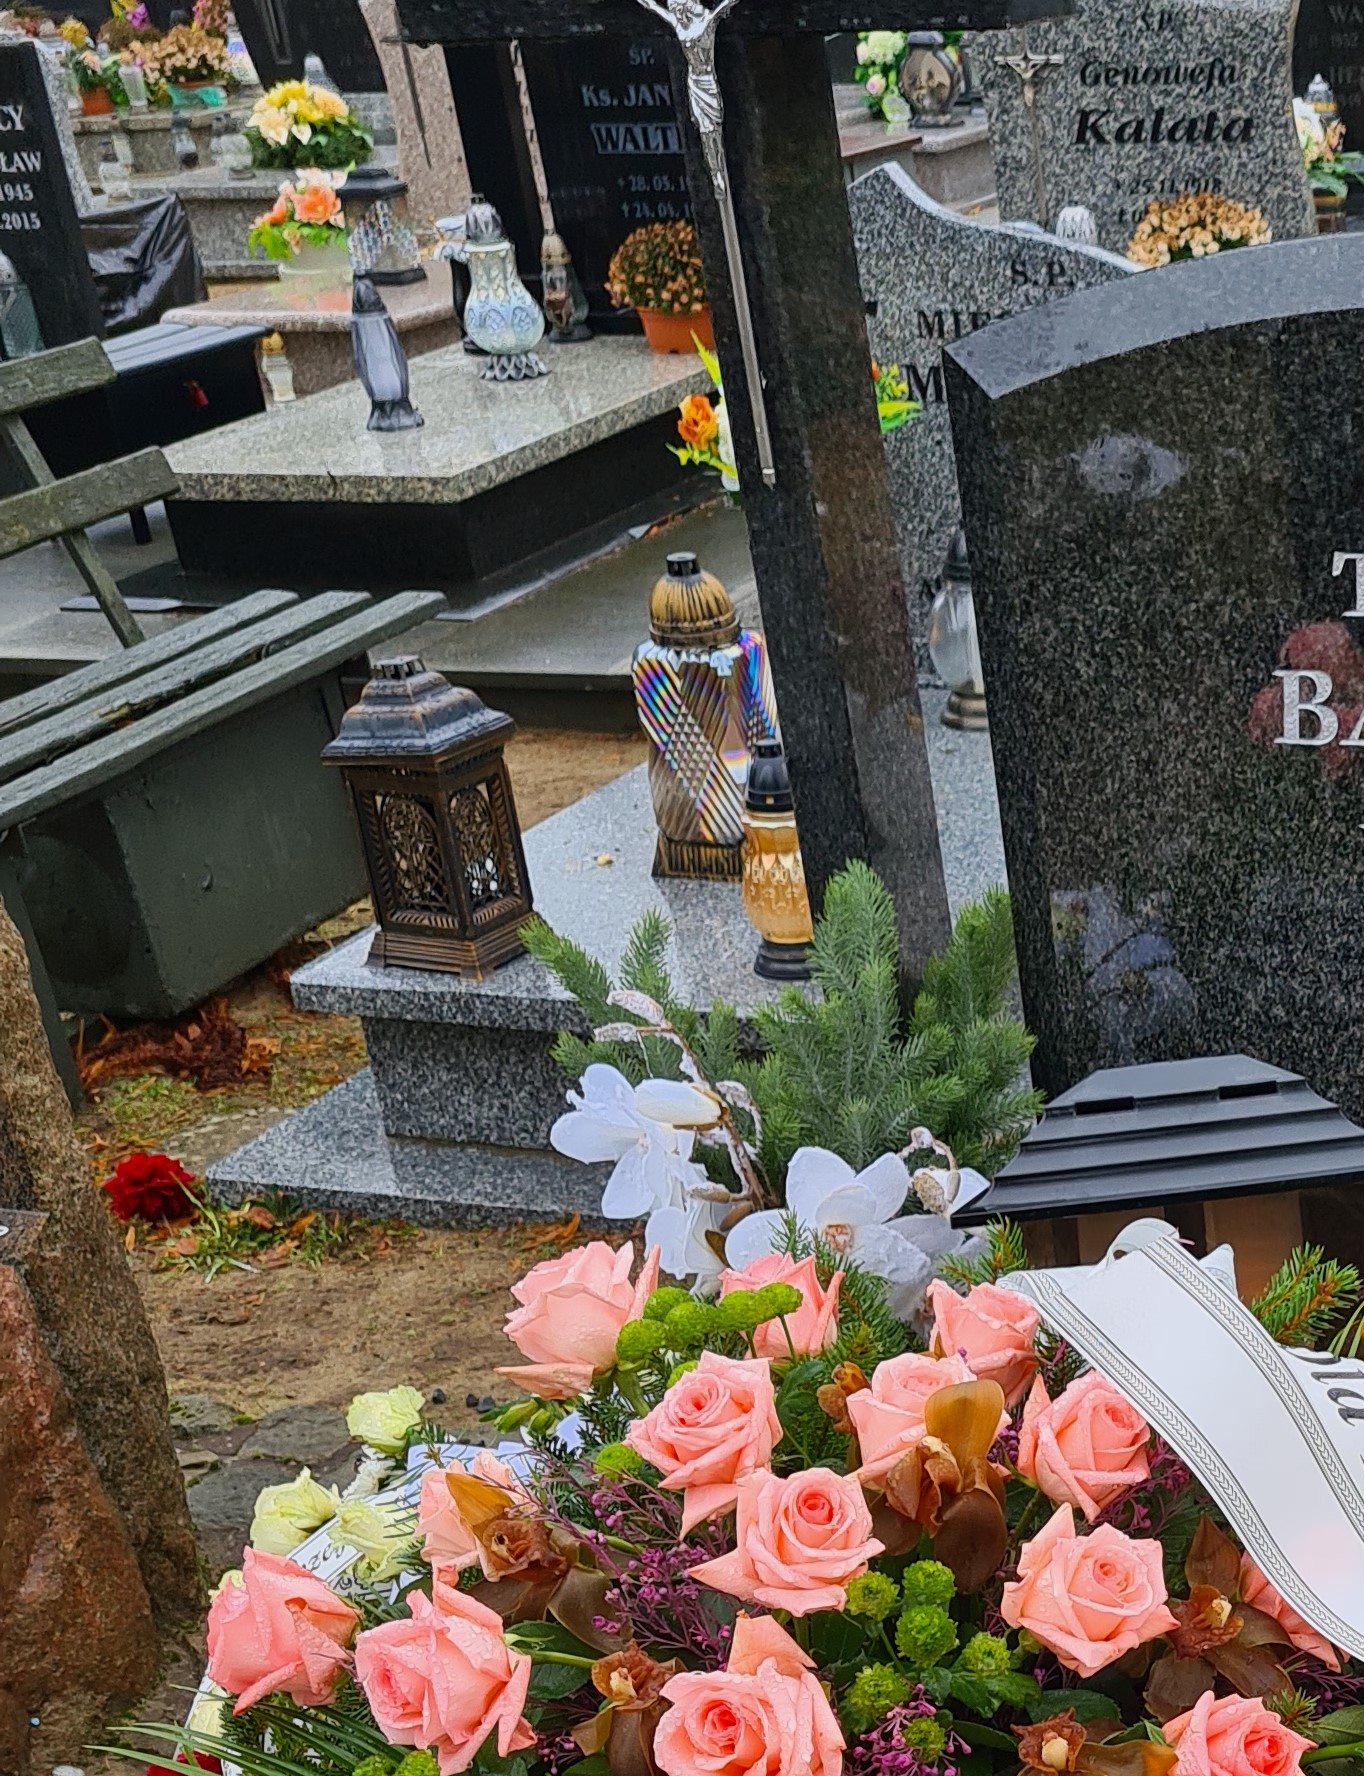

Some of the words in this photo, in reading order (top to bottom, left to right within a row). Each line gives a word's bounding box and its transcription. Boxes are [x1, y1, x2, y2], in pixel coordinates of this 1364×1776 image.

[1080, 57, 1237, 92] Genowefa
[623, 84, 672, 107] JAN
[1074, 106, 1255, 145] Kalata
